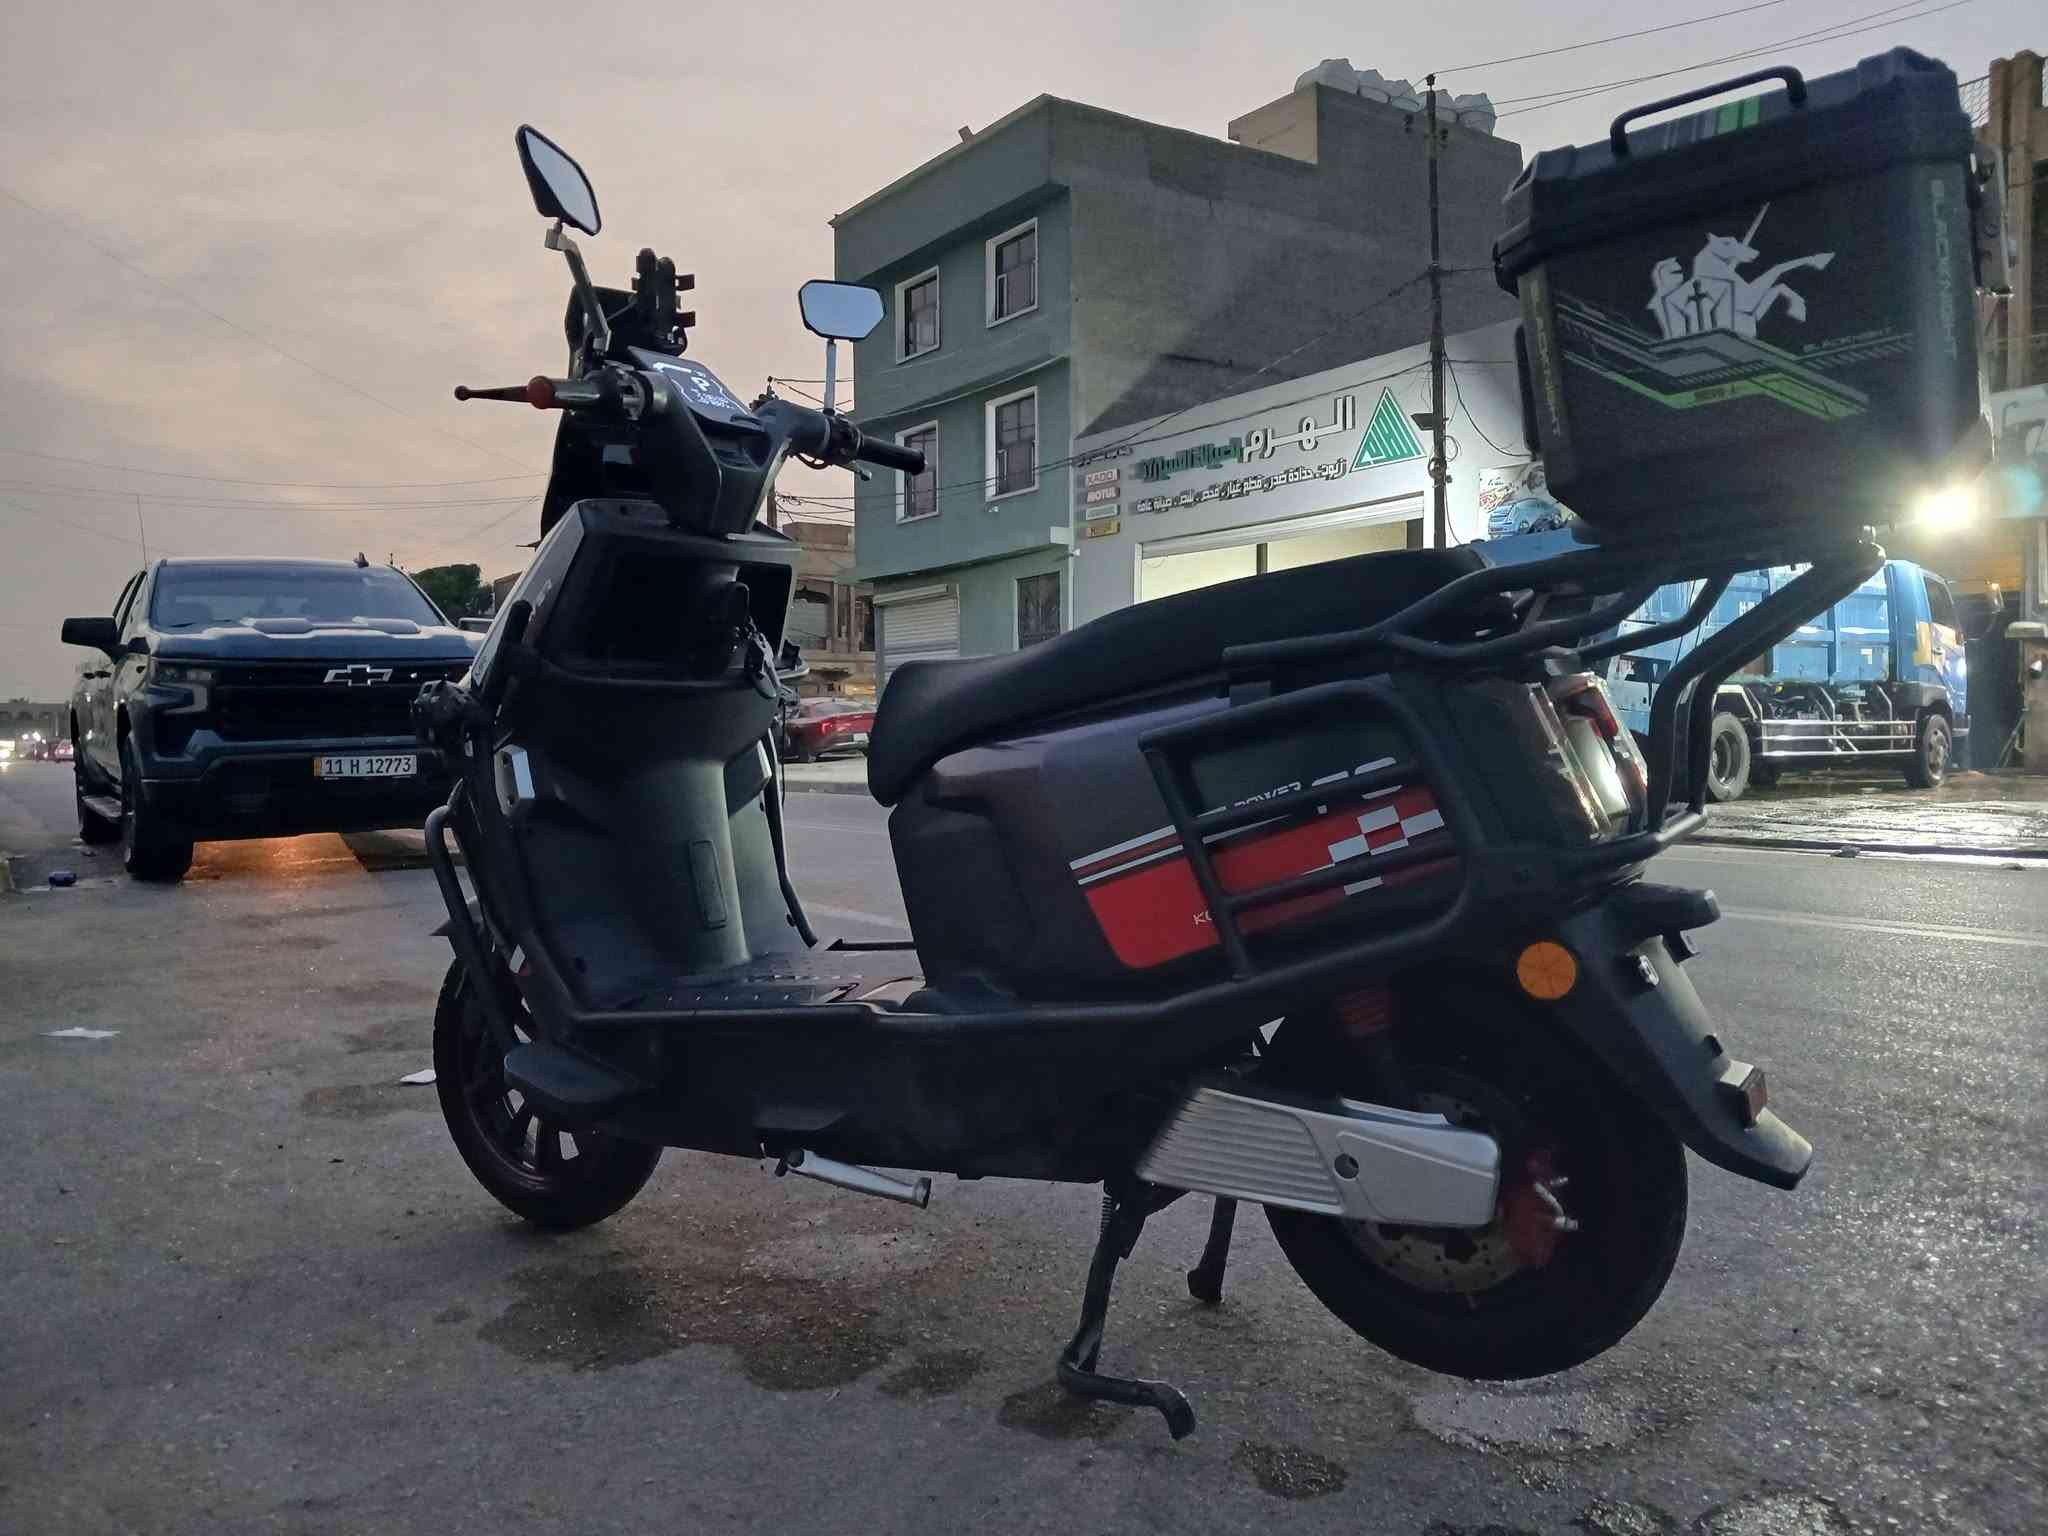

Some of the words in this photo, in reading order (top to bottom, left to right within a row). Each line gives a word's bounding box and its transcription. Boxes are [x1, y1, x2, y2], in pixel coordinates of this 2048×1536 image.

[1242, 395, 1354, 463] الهرم
[1087, 487, 1116, 502] MOTUL
[326, 759, 344, 774] 11
[350, 759, 360, 774] H
[366, 757, 411, 774] 12773
